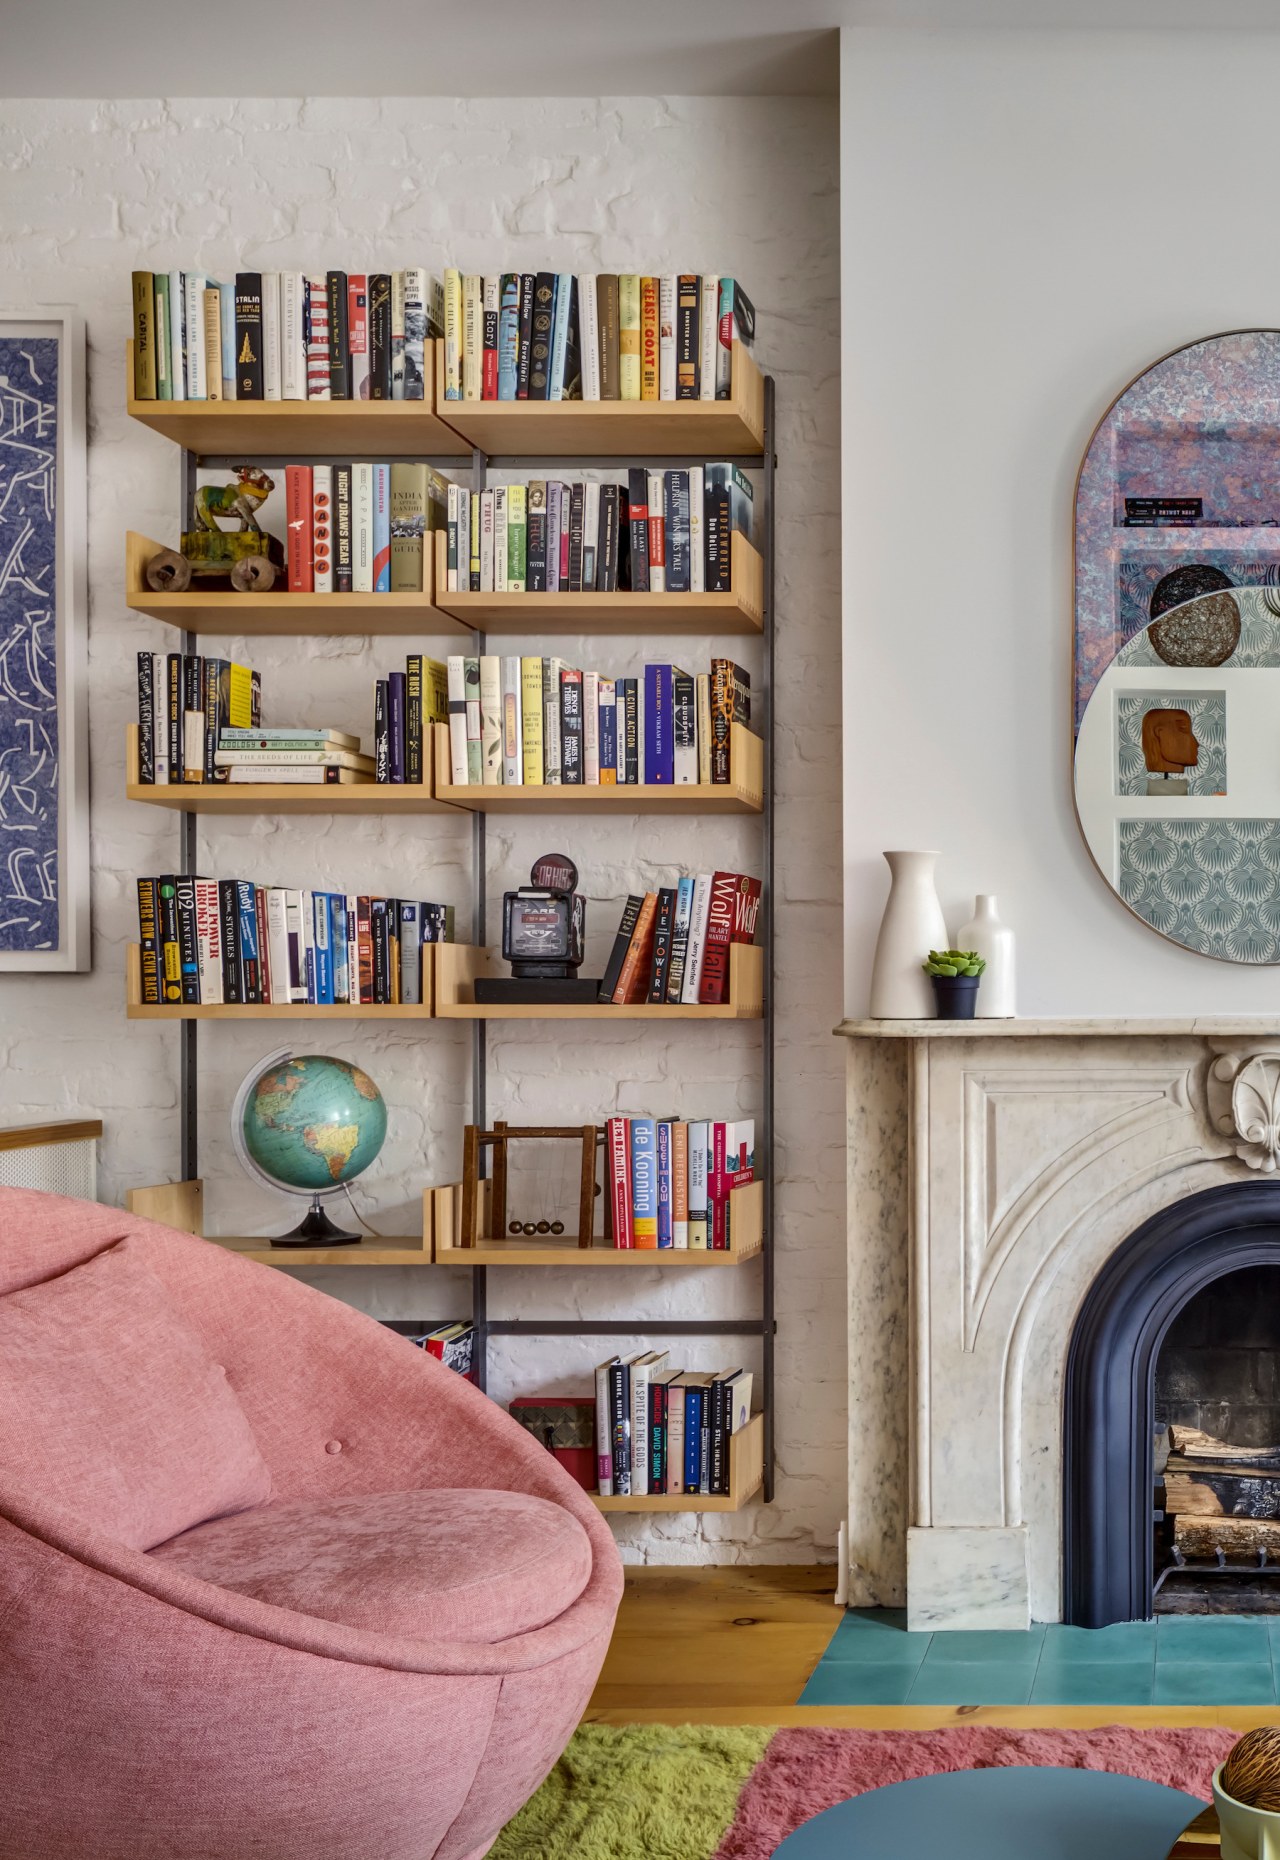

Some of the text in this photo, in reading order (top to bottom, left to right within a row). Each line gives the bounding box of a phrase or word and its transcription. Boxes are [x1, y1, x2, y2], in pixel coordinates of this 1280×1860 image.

[486, 284, 496, 347] True Story
[644, 289, 655, 321] FEAST
[139, 313, 147, 353] CAPITAL
[645, 329, 655, 367] GOAT
[521, 341, 529, 382] Ravelstein
[338, 471, 349, 564] NIGHT DRAWS NEAR
[360, 485, 368, 524] CAPA
[672, 474, 681, 571] HELPRIN WINTER'S TALE
[318, 495, 326, 571] PANIC
[530, 517, 539, 552] THUG
[709, 518, 717, 561] Don DeLillo
[720, 502, 728, 577] UNDERWORLD
[409, 659, 419, 673] THE
[409, 677, 420, 696] RUSH
[571, 704, 578, 714] OF
[177, 880, 194, 962] 102 MINUTES
[197, 884, 208, 937] BROKER
[208, 881, 219, 958] THE POWER
[680, 898, 688, 915] HORNE
[695, 904, 704, 936] Anything?
[709, 878, 736, 927] Wolf
[139, 882, 157, 1000] STRIVERS ROW KEVIN BAKER
[226, 916, 234, 957] STORIES
[654, 896, 669, 987] THE POWER
[691, 941, 700, 958] Jerry
[708, 926, 730, 934] HILARY
[689, 959, 698, 985] Seinfeld
[704, 943, 726, 979] Hall
[614, 1122, 625, 1183] RED FAMINE
[634, 1127, 653, 1211] de Kooning
[660, 1127, 668, 1201] SWEET LOW
[676, 1154, 684, 1216] RIEFENSTAHL
[636, 1391, 645, 1413] SPITE
[636, 1416, 645, 1425] OF
[636, 1429, 645, 1443] THE
[653, 1386, 662, 1478] HOMICIDE DAVID SIMON
[636, 1447, 645, 1468] GODS
